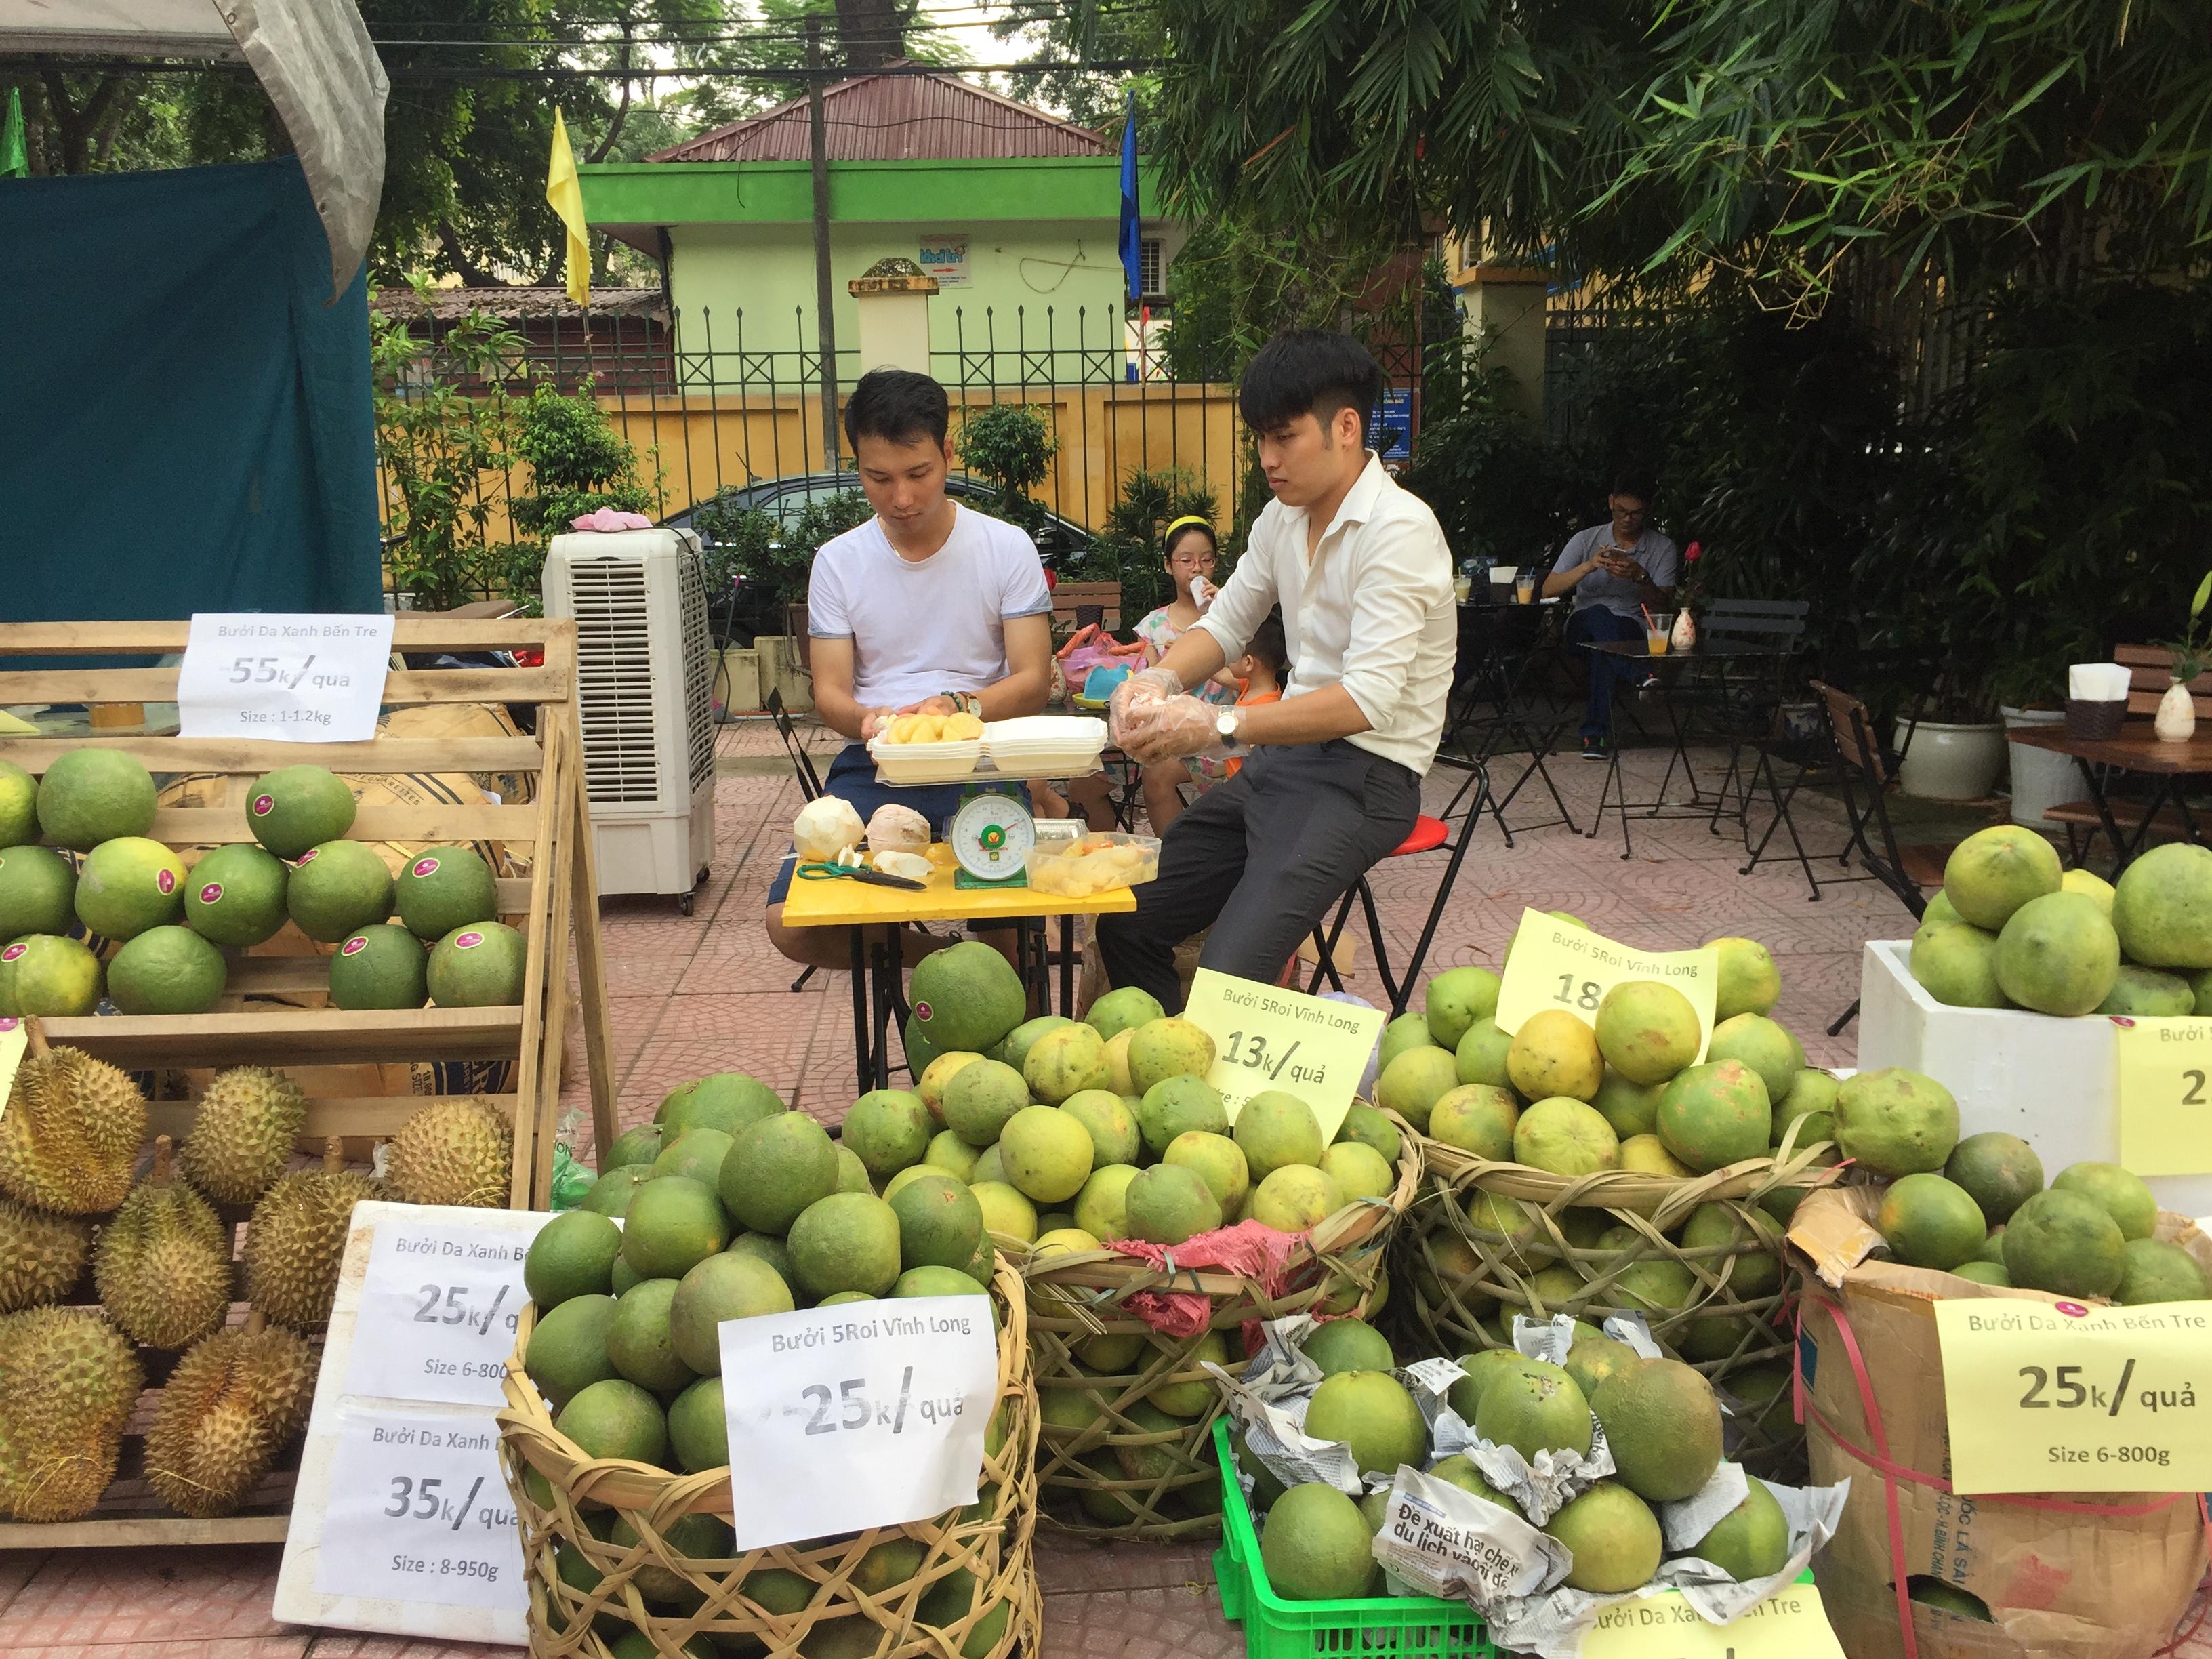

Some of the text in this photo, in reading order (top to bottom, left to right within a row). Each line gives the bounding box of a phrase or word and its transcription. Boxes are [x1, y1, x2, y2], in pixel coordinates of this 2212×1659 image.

[218, 623, 377, 637] Bưởi Da Xanh Bến Tre
[241, 710, 267, 722] Size
[280, 710, 332, 726] 1-1.2kg
[1552, 931, 1698, 978] Bưởi 5Roi Vĩnh Long
[1223, 988, 1360, 1035] Bưởi 5Roi Vĩnh Long
[2160, 1025, 2204, 1042] Bưởi
[396, 1237, 437, 1254] Bưởi
[442, 1242, 463, 1256] Da
[468, 1244, 508, 1260] Xanh
[772, 1316, 971, 1352] Bưởi 5Roi Vĩnh Long
[1969, 1314, 2206, 1332] Bưởi Da Xanh Bến Tre
[424, 1359, 457, 1376] Size
[373, 1427, 415, 1445] Bưởi
[419, 1431, 441, 1447] Da
[446, 1433, 489, 1450] Xanh
[2049, 1446, 2170, 1466] Size 6-800g
[1399, 1503, 1421, 1526] Đề
[1423, 1519, 1460, 1546] xuất
[1394, 1521, 1415, 1544] du
[1417, 1531, 1448, 1557] lịch
[392, 1555, 425, 1572] Size
[440, 1559, 499, 1582] 8-950g
[1593, 1607, 1634, 1629] ưởi
[1639, 1608, 1666, 1626] Da
[1767, 1598, 1801, 1615] Tre
